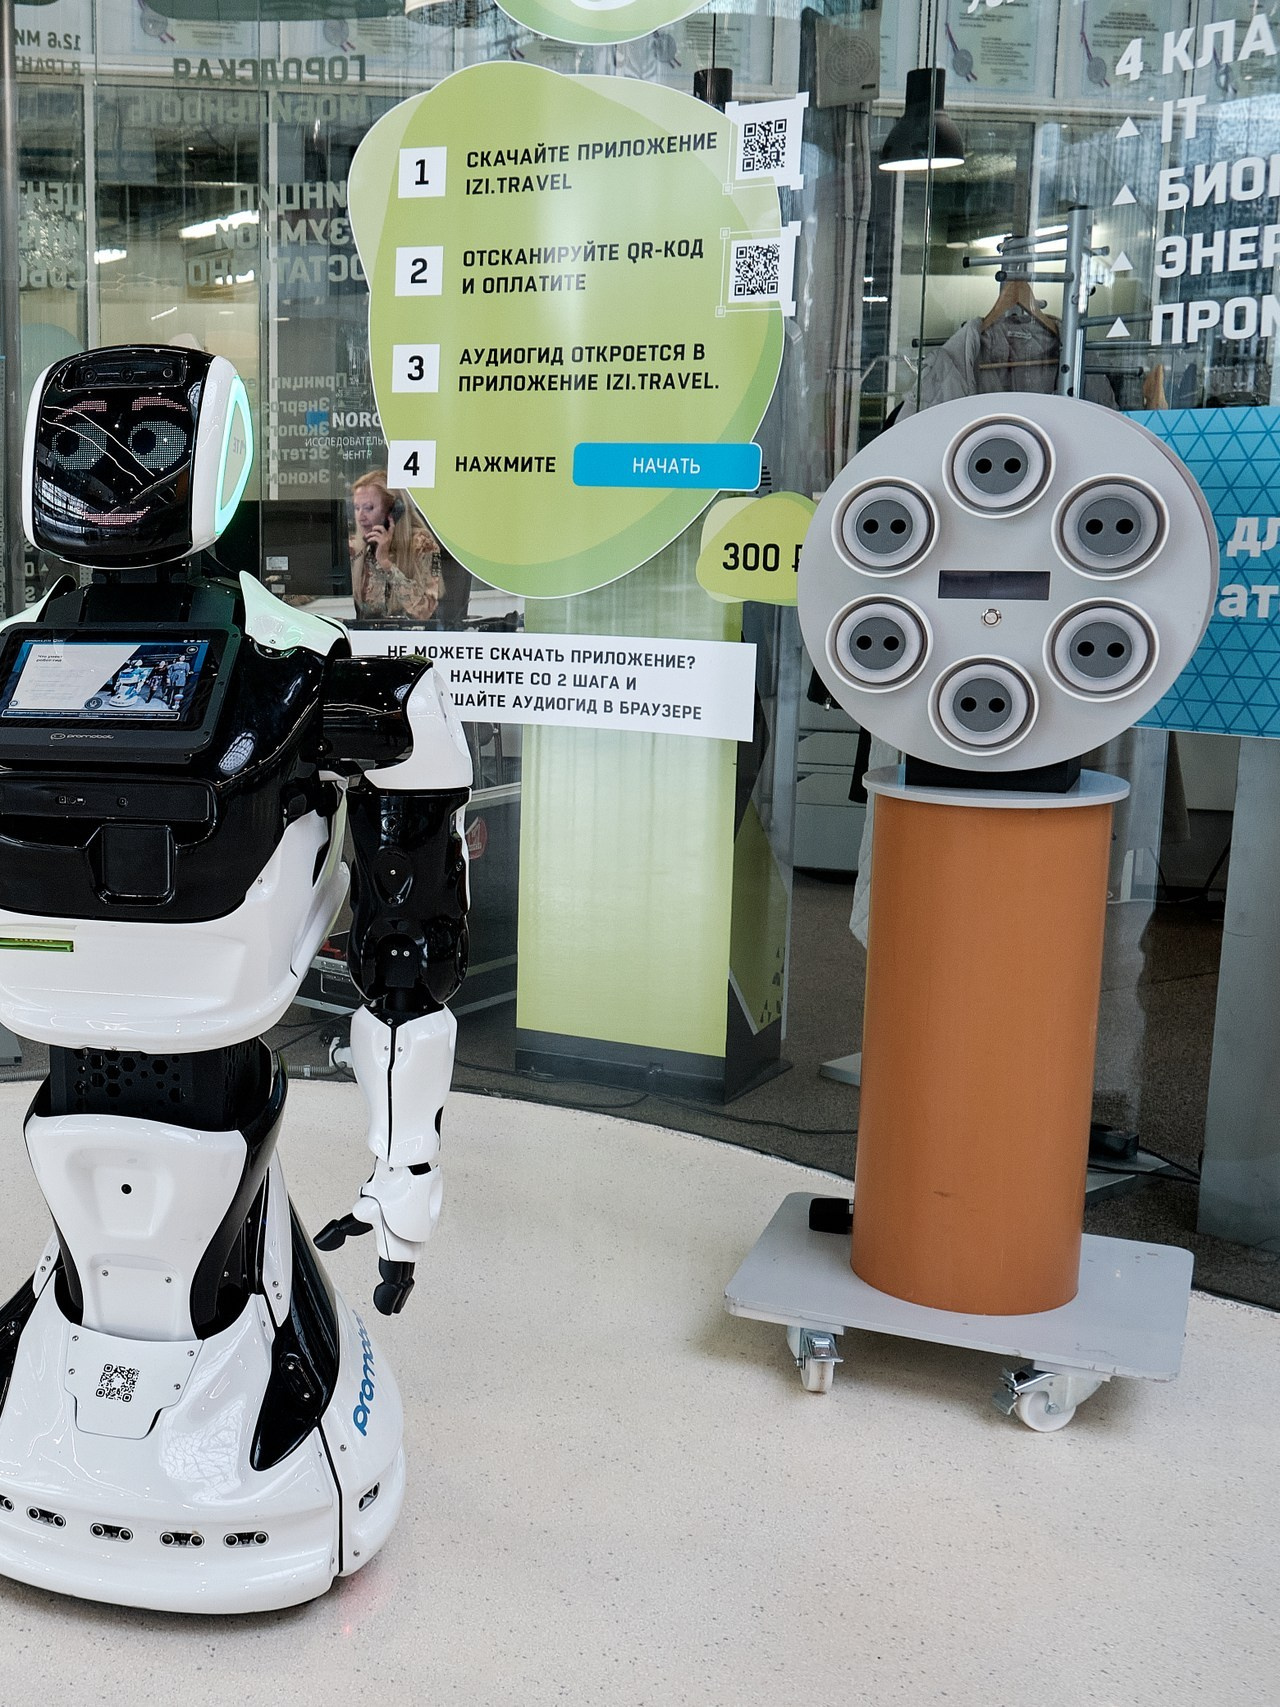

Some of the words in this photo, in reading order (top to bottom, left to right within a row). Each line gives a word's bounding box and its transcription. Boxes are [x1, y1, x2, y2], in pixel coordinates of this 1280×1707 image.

[1115, 38, 1144, 81] 4
[1162, 13, 1278, 76] КЛА
[1160, 94, 1206, 143] IT
[414, 159, 429, 186] 1
[466, 146, 570, 168] СКАЧАЙТЕ
[578, 132, 718, 161] ПРИЛОЖЕНИЕ
[466, 174, 572, 196] IZI.TRAVEL
[410, 258, 428, 284] 2
[463, 240, 620, 268] ОТСКАНИРУЙТЕ
[626, 238, 704, 261] QR-КОД
[462, 278, 474, 294] И
[482, 274, 586, 293] ОПЛАТИТЕ
[407, 356, 425, 382] 3
[459, 346, 564, 368] АУДИОГИД
[571, 344, 685, 364] ОТКРОЕТСЯ
[693, 344, 706, 360] В
[458, 374, 598, 392] ПРИЛОЖЕНИЕ
[606, 372, 720, 391] IZI.TRAVEL.
[305, 436, 387, 448] ИССЛЕДОВАТЕЛЬ
[403, 450, 420, 476] 4
[455, 456, 556, 474] НАЖМИТЕ
[632, 457, 701, 476] НАЧАТЬ
[722, 542, 780, 572] 300
[1212, 584, 1280, 618] ат
[387, 644, 408, 658] НЕ
[414, 644, 484, 661] МОЖЕТЕ
[490, 646, 565, 664] СКАЧАТЬ
[570, 649, 696, 670] ПРИЛОЖЕНИЕ?
[450, 670, 524, 686] НАЧНИТЕ
[530, 672, 552, 687] СО
[558, 672, 567, 687] 2
[572, 674, 620, 690] ШАГА
[626, 676, 638, 691] И
[450, 690, 506, 709] ШАЙТЕ
[512, 695, 598, 715] АУДИОГИД
[603, 698, 613, 714] В
[619, 700, 702, 721] БРАУЗЕРЕ
